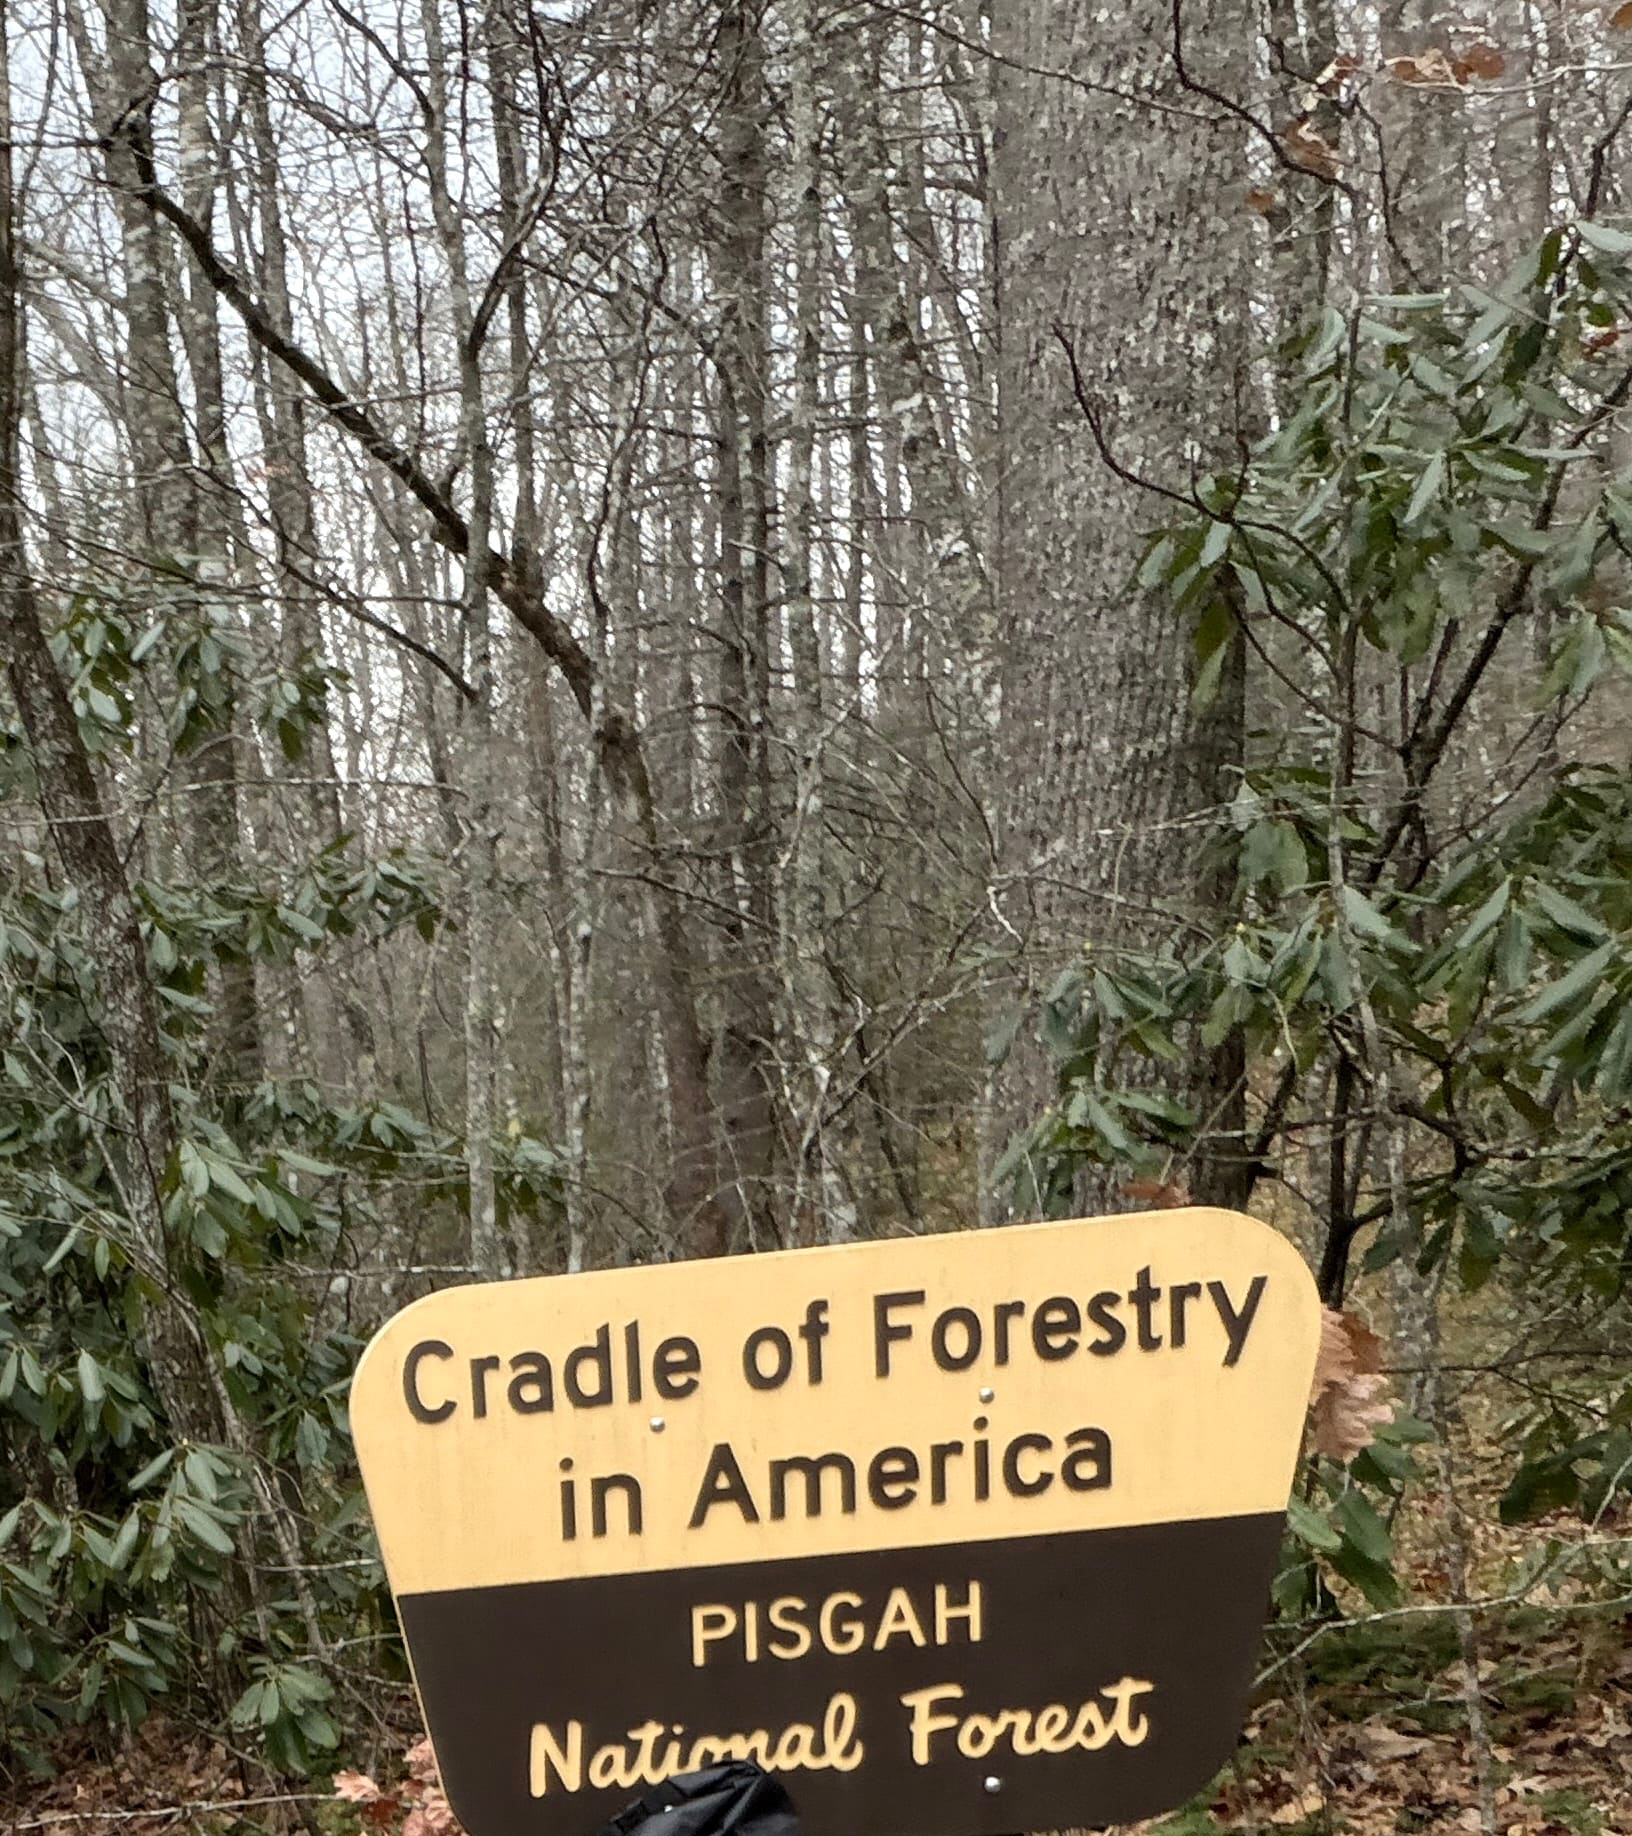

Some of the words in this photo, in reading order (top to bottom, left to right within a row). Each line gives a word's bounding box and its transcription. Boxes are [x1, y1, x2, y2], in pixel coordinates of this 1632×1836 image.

[401, 1320, 703, 1426] Cradle
[741, 1299, 831, 1392] of
[872, 1265, 1269, 1379] Forestry
[558, 1457, 644, 1542] in
[687, 1416, 1113, 1530] America
[691, 1580, 983, 1668] PISGAH
[899, 1676, 1155, 1767] Forest
